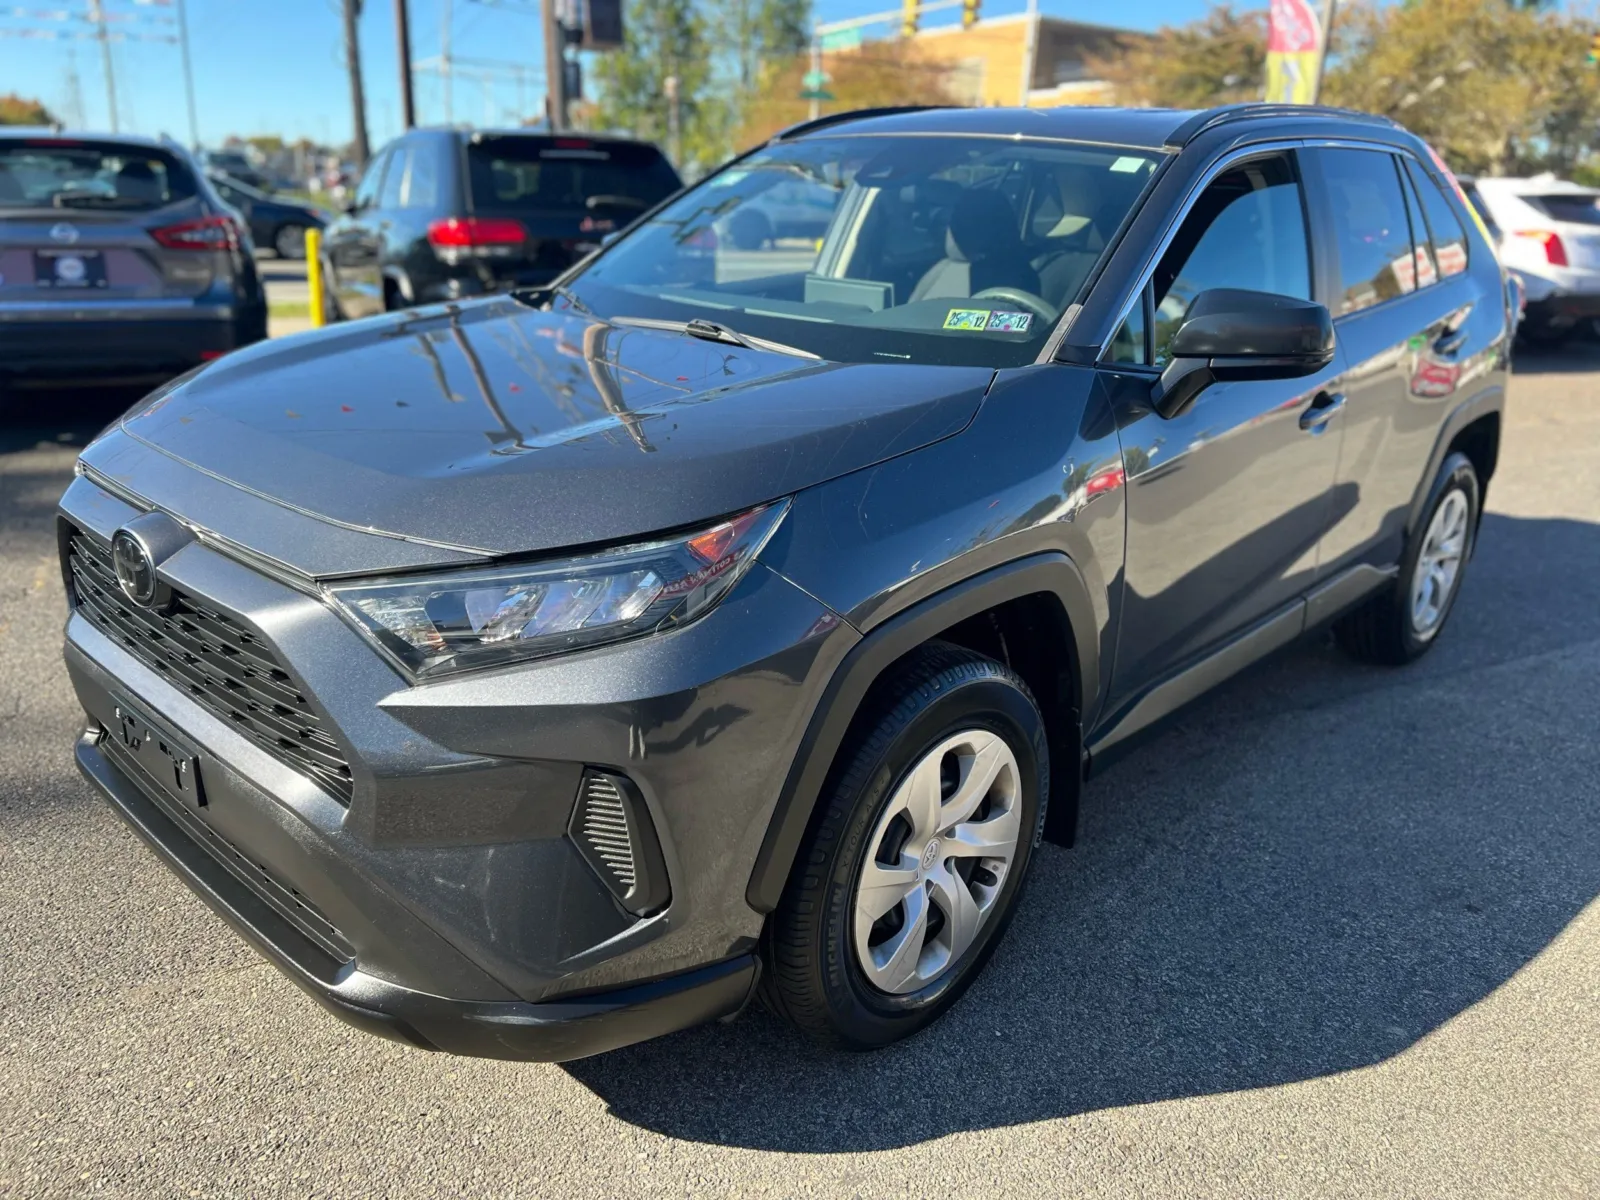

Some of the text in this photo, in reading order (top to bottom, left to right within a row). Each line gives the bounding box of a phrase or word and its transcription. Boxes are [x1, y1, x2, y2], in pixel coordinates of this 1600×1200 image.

[949, 312, 985, 328] 25 12
[990, 314, 1028, 328] 25 12
[827, 887, 843, 987] MICHELIN
